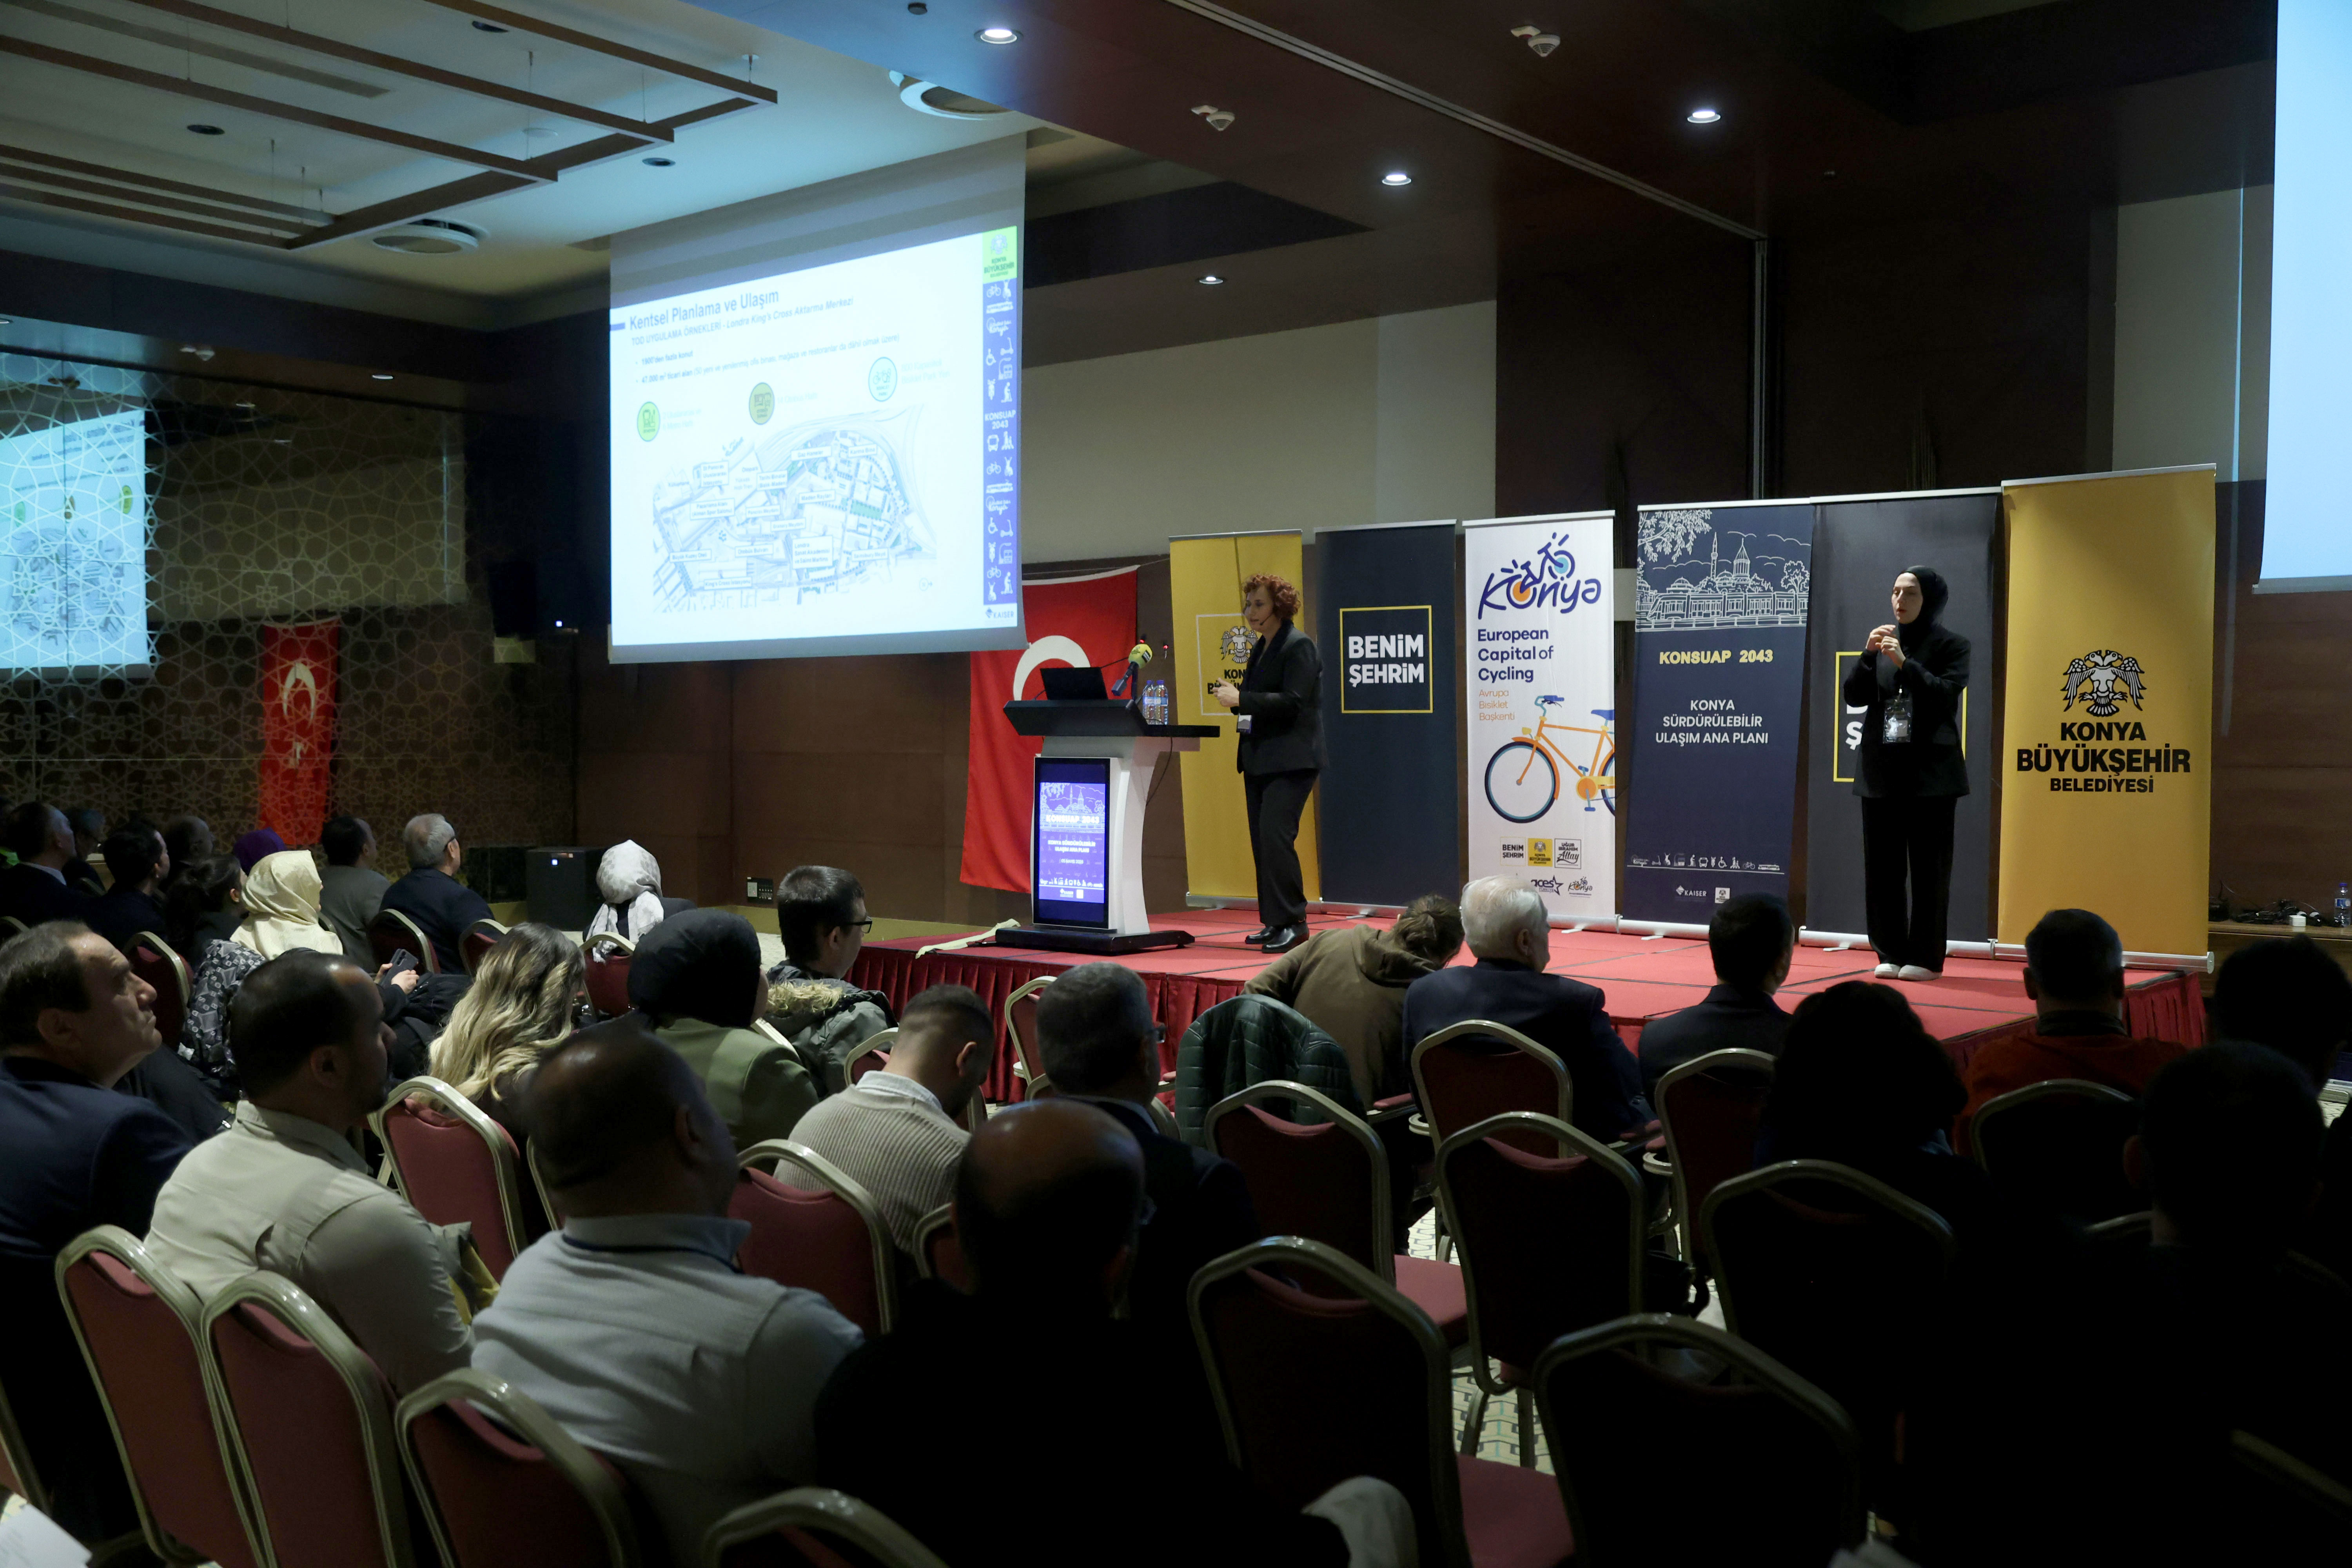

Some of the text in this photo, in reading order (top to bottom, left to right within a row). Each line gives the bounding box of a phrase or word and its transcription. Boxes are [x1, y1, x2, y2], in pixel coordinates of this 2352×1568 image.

[630, 291, 779, 330] Kentsel Planlama ve Ulaşım
[632, 336, 645, 346] TOD
[646, 329, 682, 343] UYGULAMA
[684, 319, 721, 336] ÖRNEKLERİ
[727, 318, 750, 328] Londra
[751, 312, 771, 324] King's
[773, 309, 793, 319] Cross
[795, 303, 824, 316] Aktarma
[826, 296, 853, 310] Merkezi
[678, 348, 693, 359] konut
[778, 350, 799, 362] mağaza
[808, 343, 837, 356] restoranlar
[863, 337, 880, 347] olmak
[882, 333, 900, 345] üzere)
[985, 410, 1016, 421] KONSUAP
[992, 420, 1009, 430] 2043
[1478, 627, 1549, 643] European
[1478, 646, 1554, 662] Capital of
[1659, 650, 1773, 665] KONSUAP 2043
[1224, 669, 1247, 679] KON
[1478, 666, 1534, 683] Cycling
[1479, 689, 1509, 699] Avrupa
[1479, 699, 1508, 709] Bisiklet
[1690, 700, 1735, 711] KONYA
[1479, 711, 1515, 722] Başkenti
[1663, 713, 1762, 728] SÜRDÜRÜLEBİLİR
[2060, 722, 2147, 741] KONYA
[1655, 732, 1768, 747] ULAŞIM ANA PLANI
[2017, 743, 2191, 776] BÜYÜKŞEHİR
[2050, 775, 2154, 793] BELEDİYESİ
[1046, 815, 1080, 823] KONSUAP
